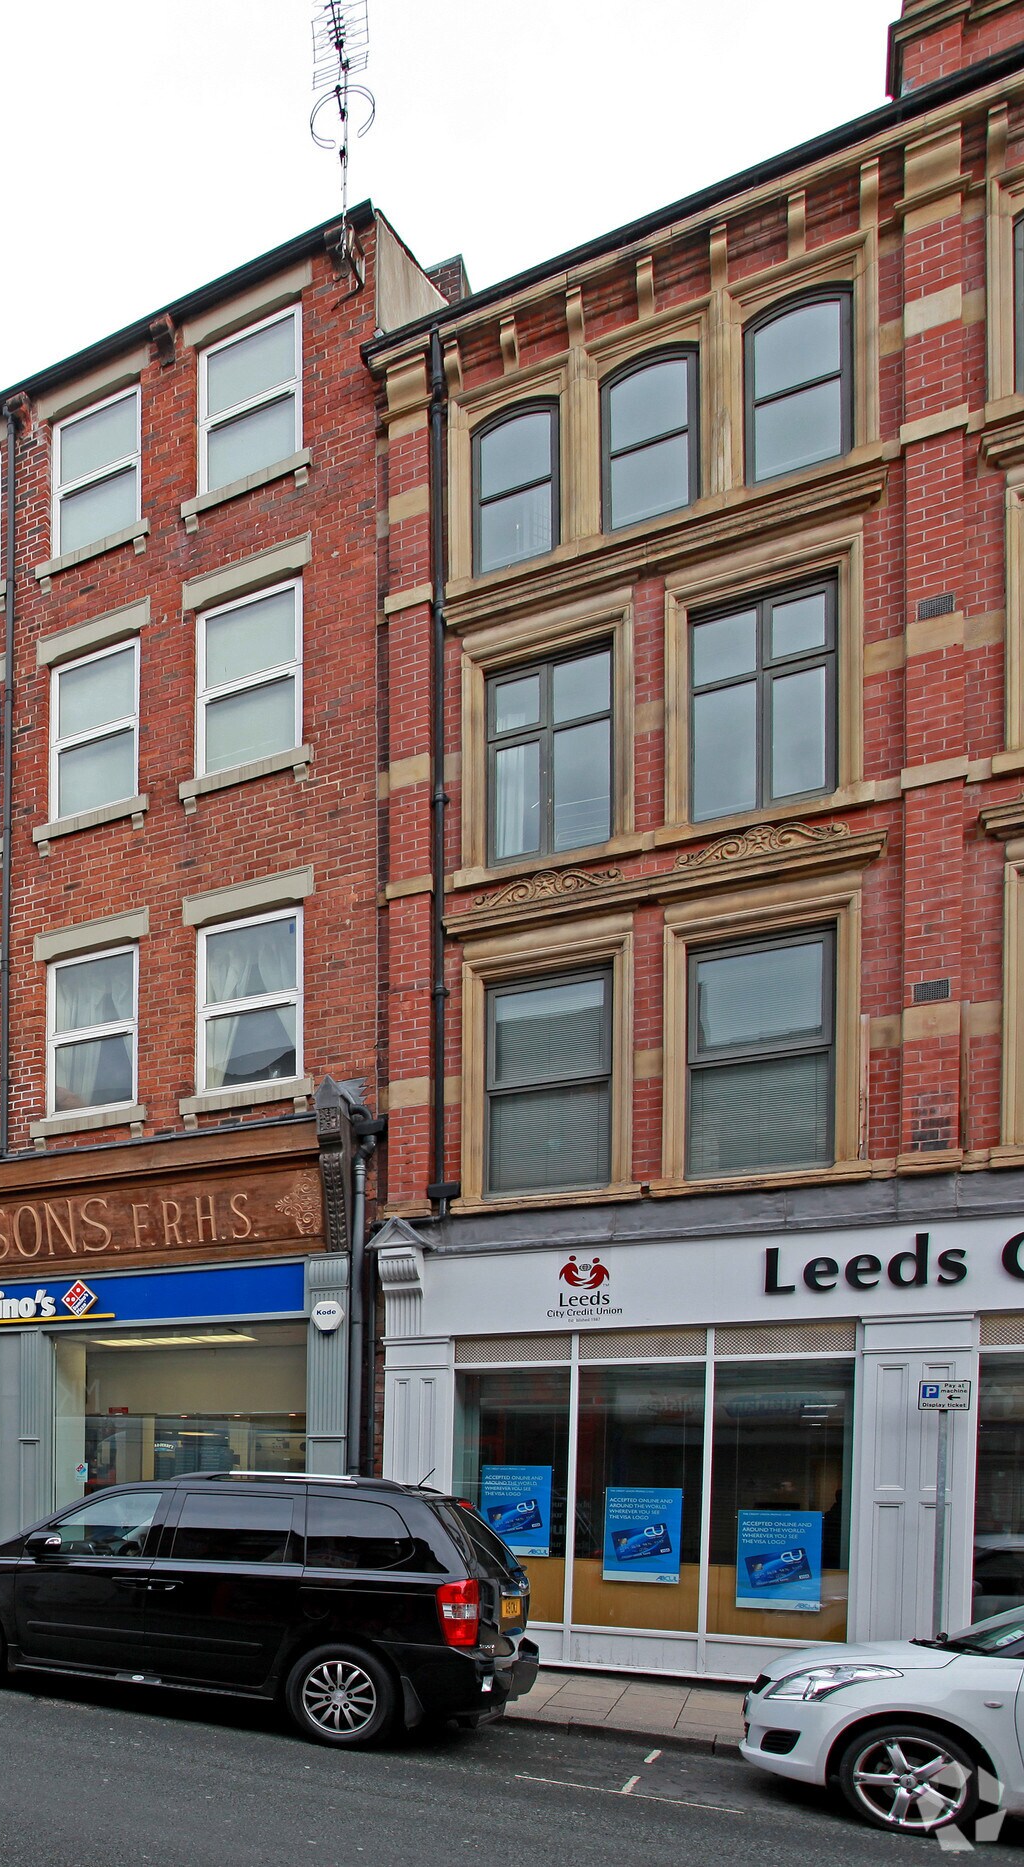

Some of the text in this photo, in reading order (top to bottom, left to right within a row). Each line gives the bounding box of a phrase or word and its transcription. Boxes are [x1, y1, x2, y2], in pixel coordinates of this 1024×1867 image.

[764, 1231, 968, 1293] Leeds
[559, 1291, 610, 1307] Leeds
[546, 1307, 622, 1318] City Credit Union
[926, 1386, 937, 1398] P
